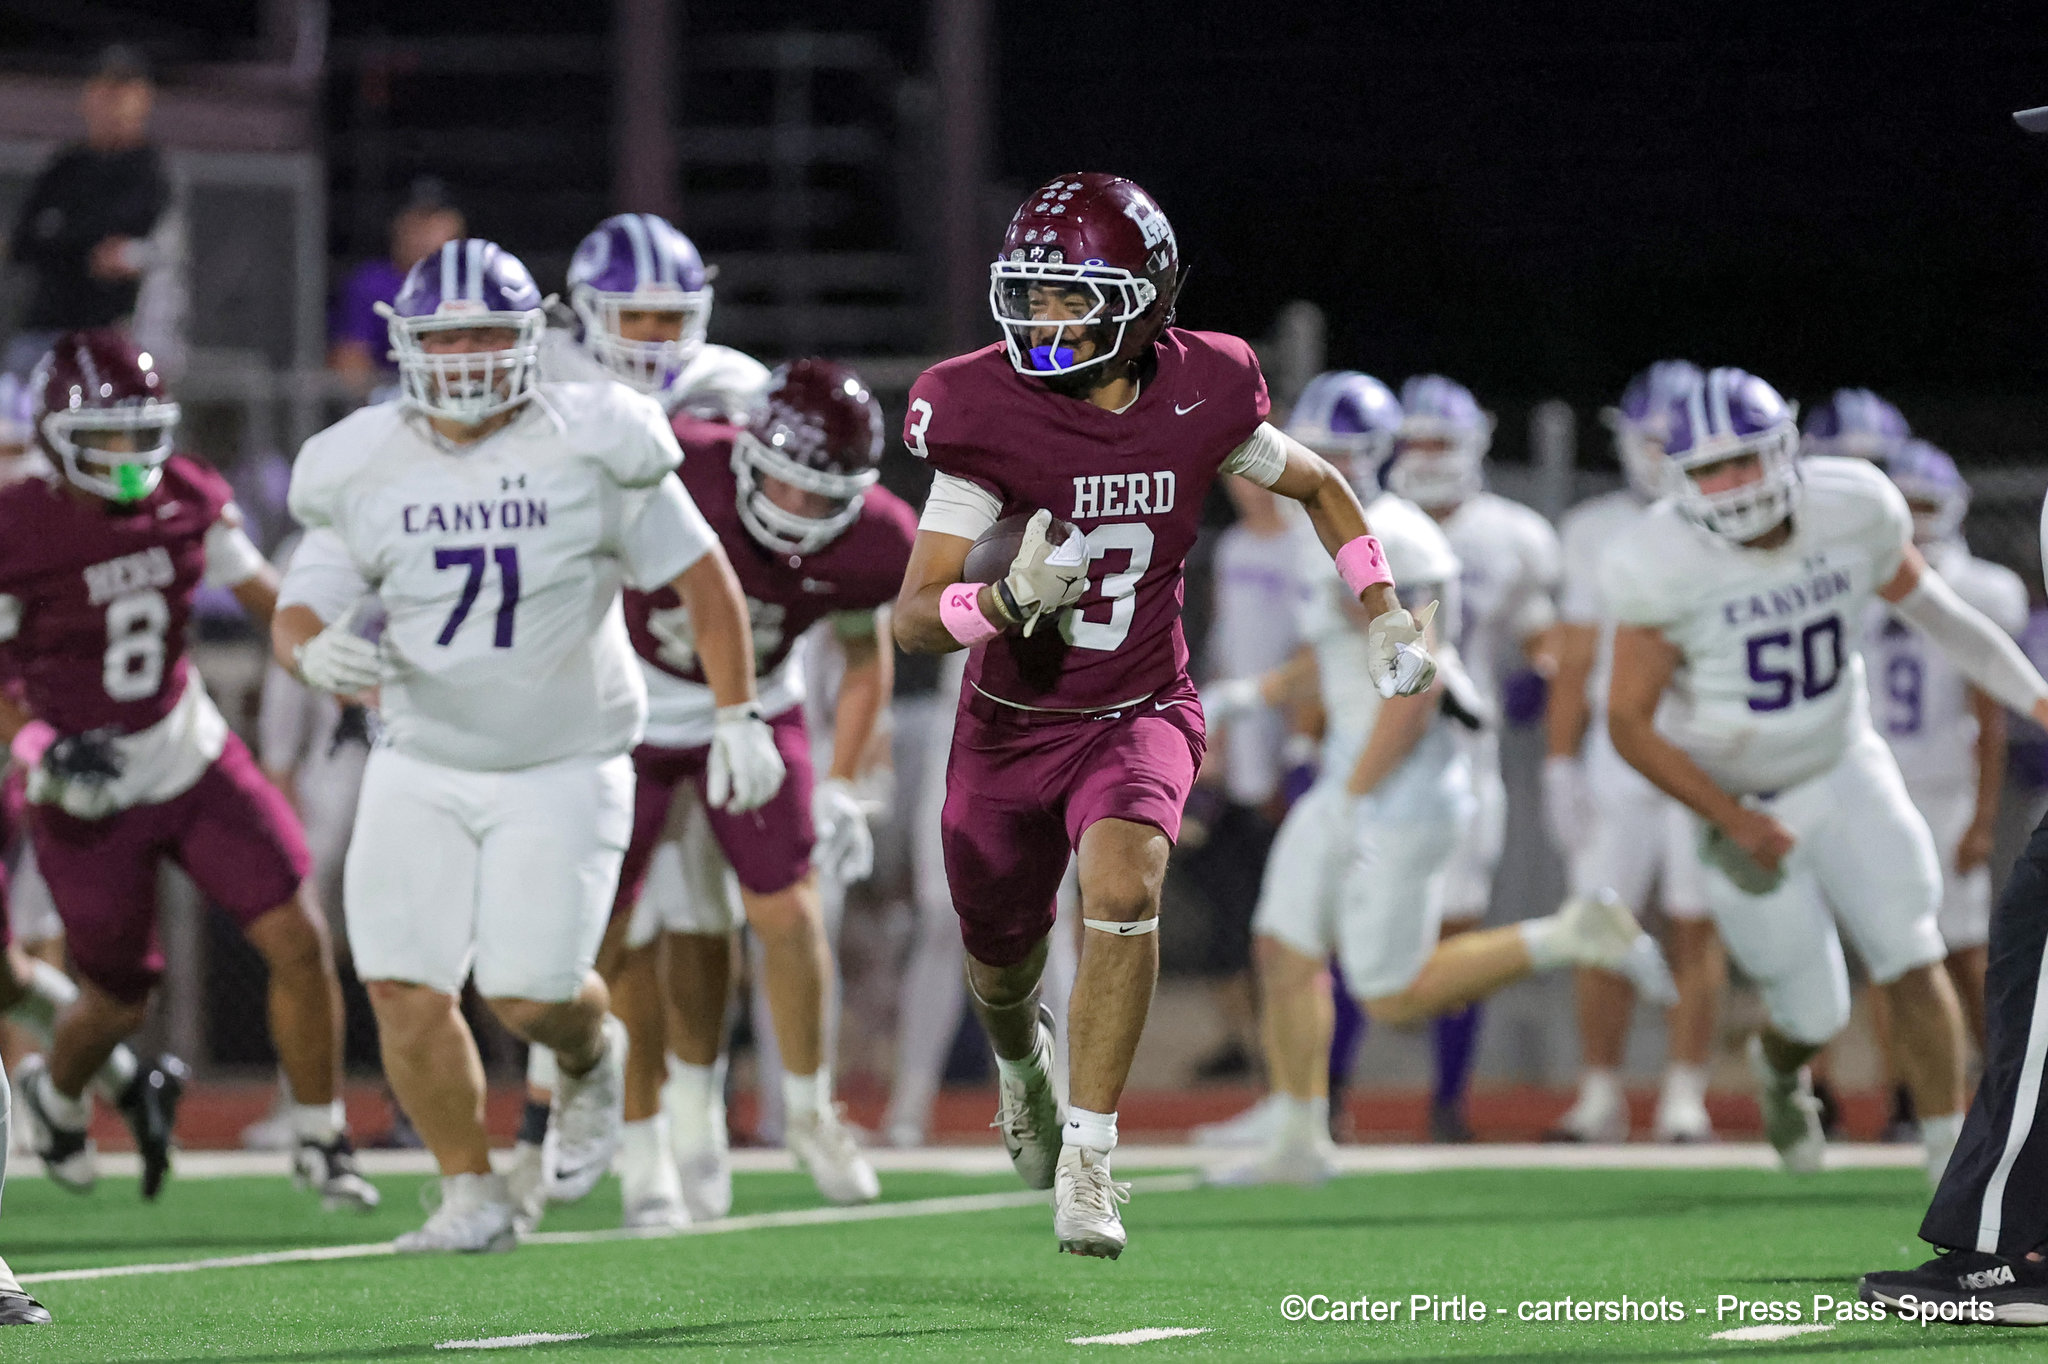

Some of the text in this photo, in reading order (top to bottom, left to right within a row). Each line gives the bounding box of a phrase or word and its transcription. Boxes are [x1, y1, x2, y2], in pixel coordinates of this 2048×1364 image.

[904, 398, 933, 459] 3
[403, 499, 548, 533] CANYON
[1071, 470, 1176, 519] HERD
[434, 545, 520, 648] 71
[1058, 522, 1155, 651] 3
[1723, 569, 1850, 625] CANYON
[103, 588, 170, 702] 8
[1746, 612, 1843, 712] 50
[1957, 1264, 2017, 1290] HOKA
